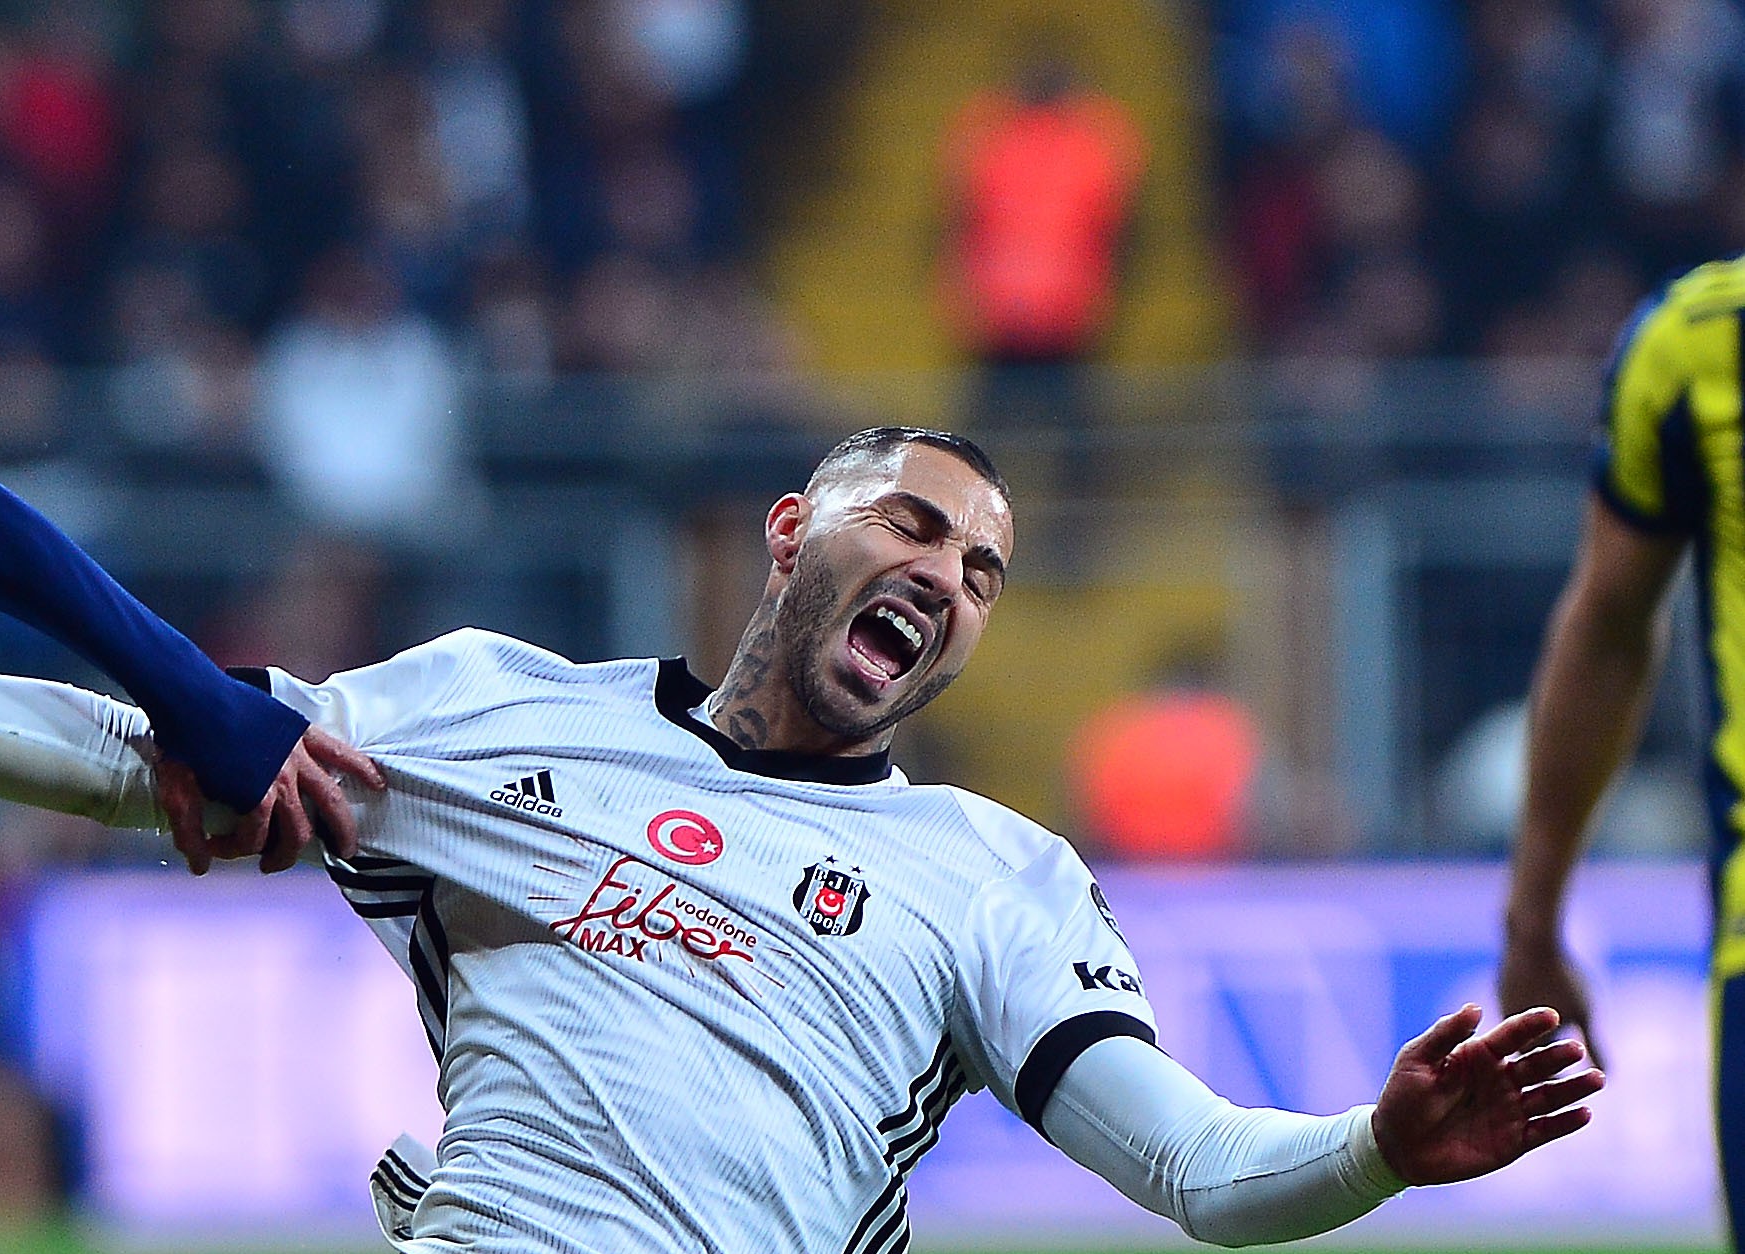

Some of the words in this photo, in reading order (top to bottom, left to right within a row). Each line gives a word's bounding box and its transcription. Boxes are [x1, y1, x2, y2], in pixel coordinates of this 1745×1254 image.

[489, 789, 563, 818] adidas
[549, 854, 754, 963] Fiber
[675, 897, 757, 948] vodafone
[578, 927, 648, 963] MAX
